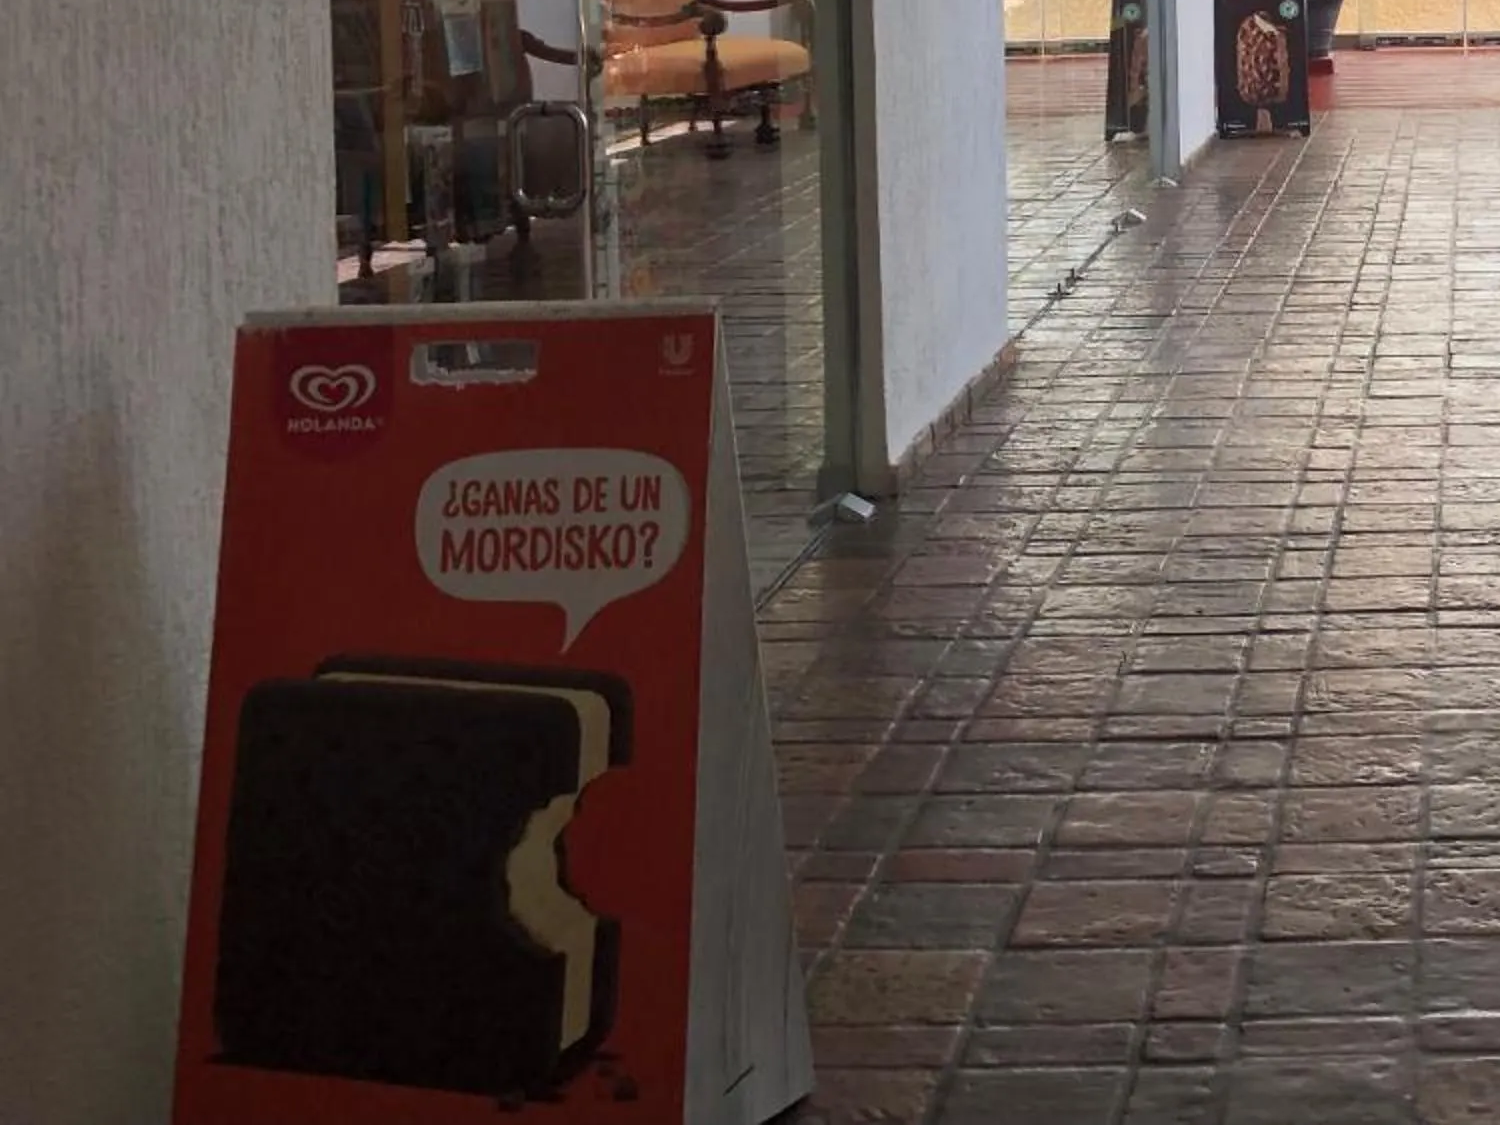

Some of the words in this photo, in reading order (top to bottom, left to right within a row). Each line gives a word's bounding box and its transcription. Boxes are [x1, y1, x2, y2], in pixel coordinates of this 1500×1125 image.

[287, 416, 377, 433] HOLANDA
[442, 479, 560, 518] ¿GANAS
[572, 477, 608, 514] DE
[618, 475, 663, 512] UN
[440, 522, 660, 573] MORDISKO?
